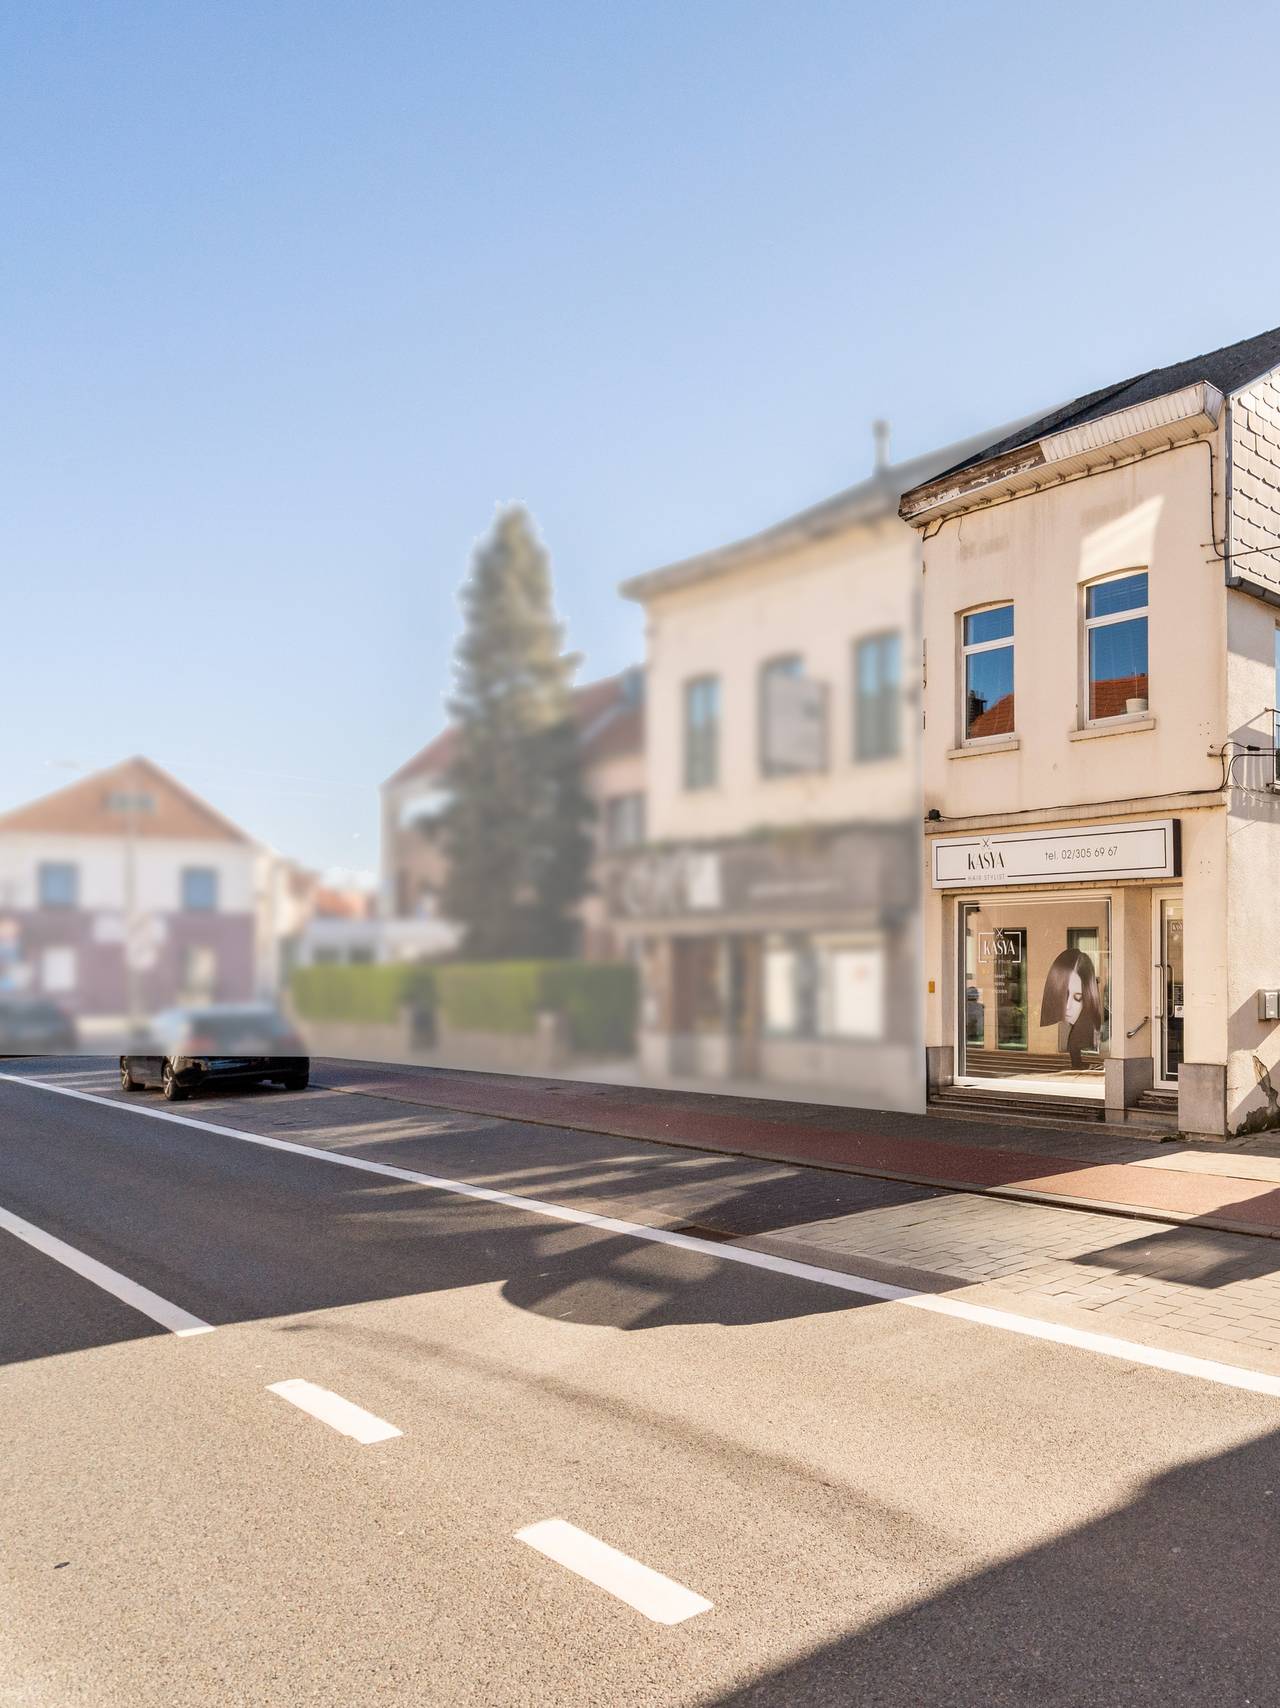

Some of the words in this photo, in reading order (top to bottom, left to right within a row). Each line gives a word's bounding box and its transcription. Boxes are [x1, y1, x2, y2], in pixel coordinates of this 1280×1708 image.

[967, 851, 1005, 870] KASYA
[1045, 850, 1059, 861] tel.
[1061, 848, 1092, 860] 02/305
[1094, 847, 1105, 858] 69
[1107, 846, 1118, 857] 67
[983, 940, 1016, 955] KASYA
